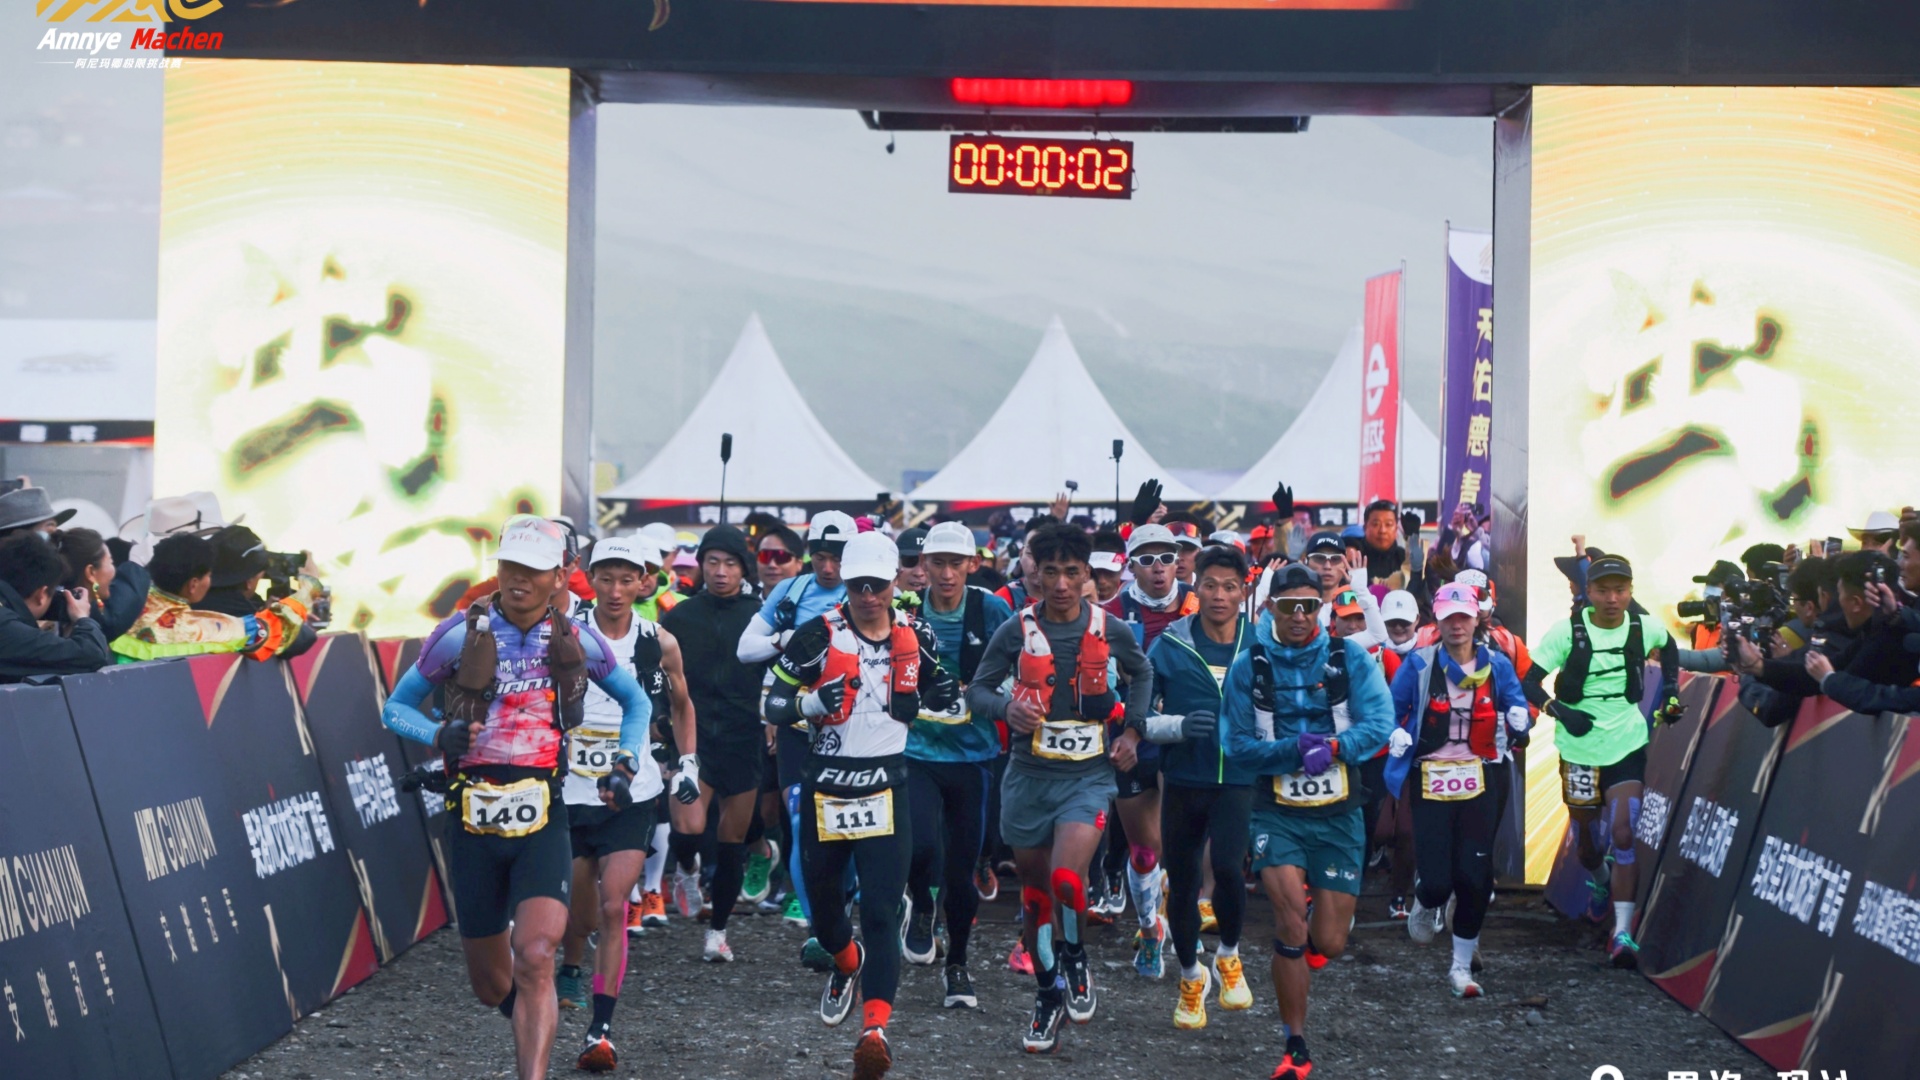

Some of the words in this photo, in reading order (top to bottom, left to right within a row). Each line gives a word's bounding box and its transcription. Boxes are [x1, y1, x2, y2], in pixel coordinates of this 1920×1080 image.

[954, 143, 1128, 191] 00:00:02
[398, 718, 428, 740] GIANT
[1046, 735, 1093, 751] 107
[817, 767, 888, 787] FUGA
[1431, 777, 1478, 793] 206
[1290, 778, 1334, 797] 101
[476, 804, 537, 826] 140
[836, 811, 876, 829] 111
